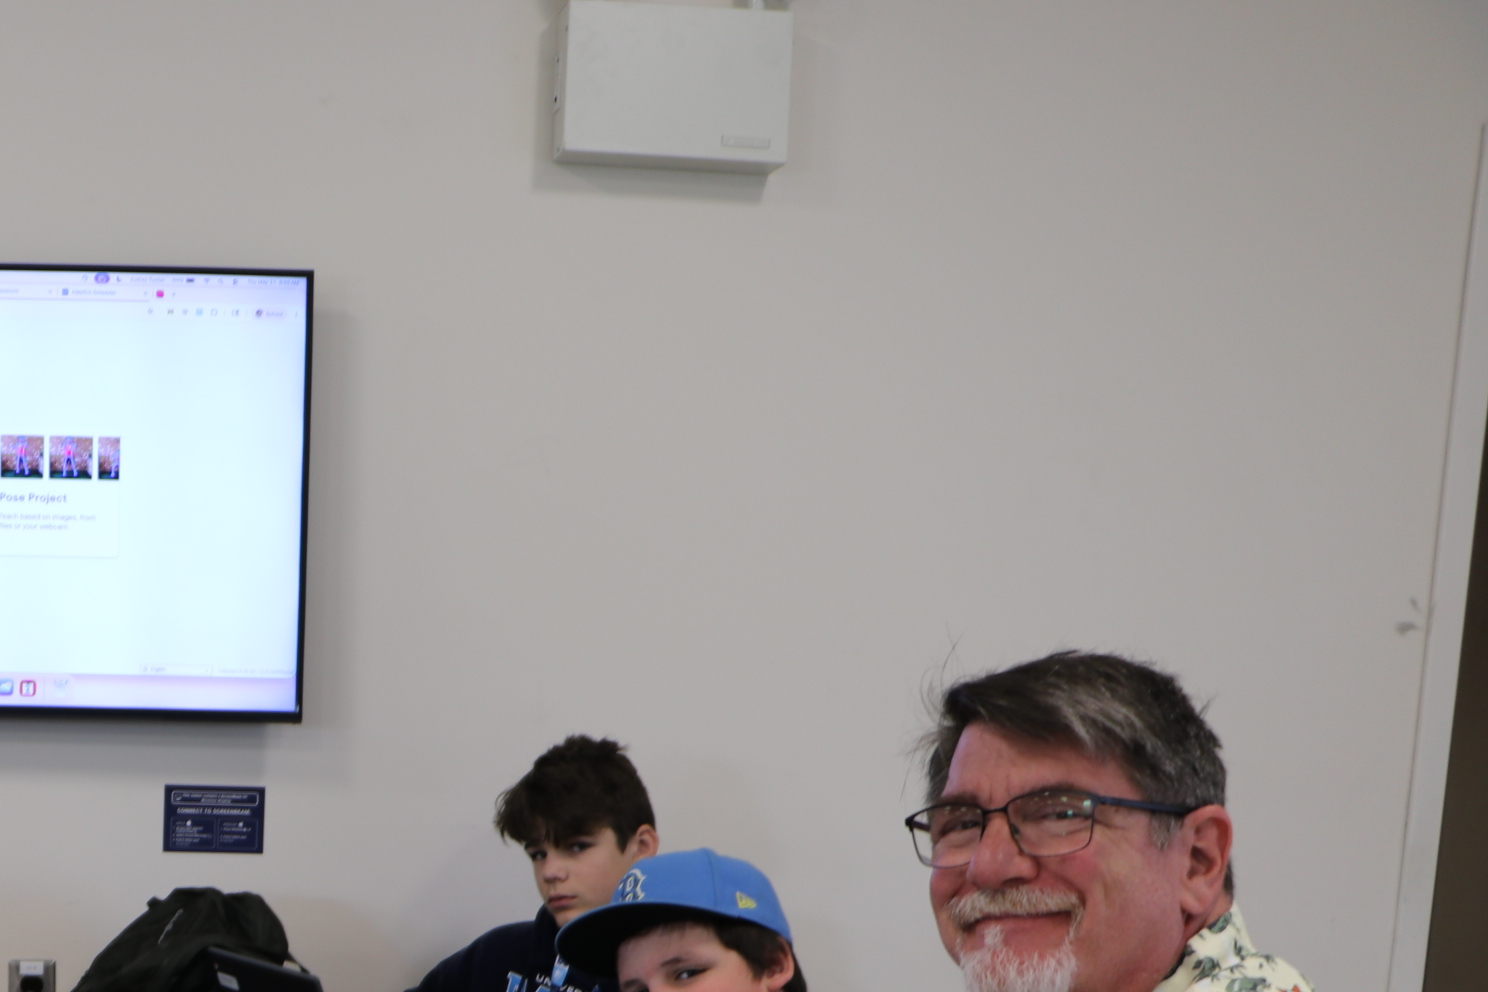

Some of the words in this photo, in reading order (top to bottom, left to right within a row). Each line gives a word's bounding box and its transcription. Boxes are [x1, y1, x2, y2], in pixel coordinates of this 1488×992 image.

[0, 492, 25, 502] Pose
[28, 492, 68, 505] Project
[176, 806, 202, 815] CONNECT
